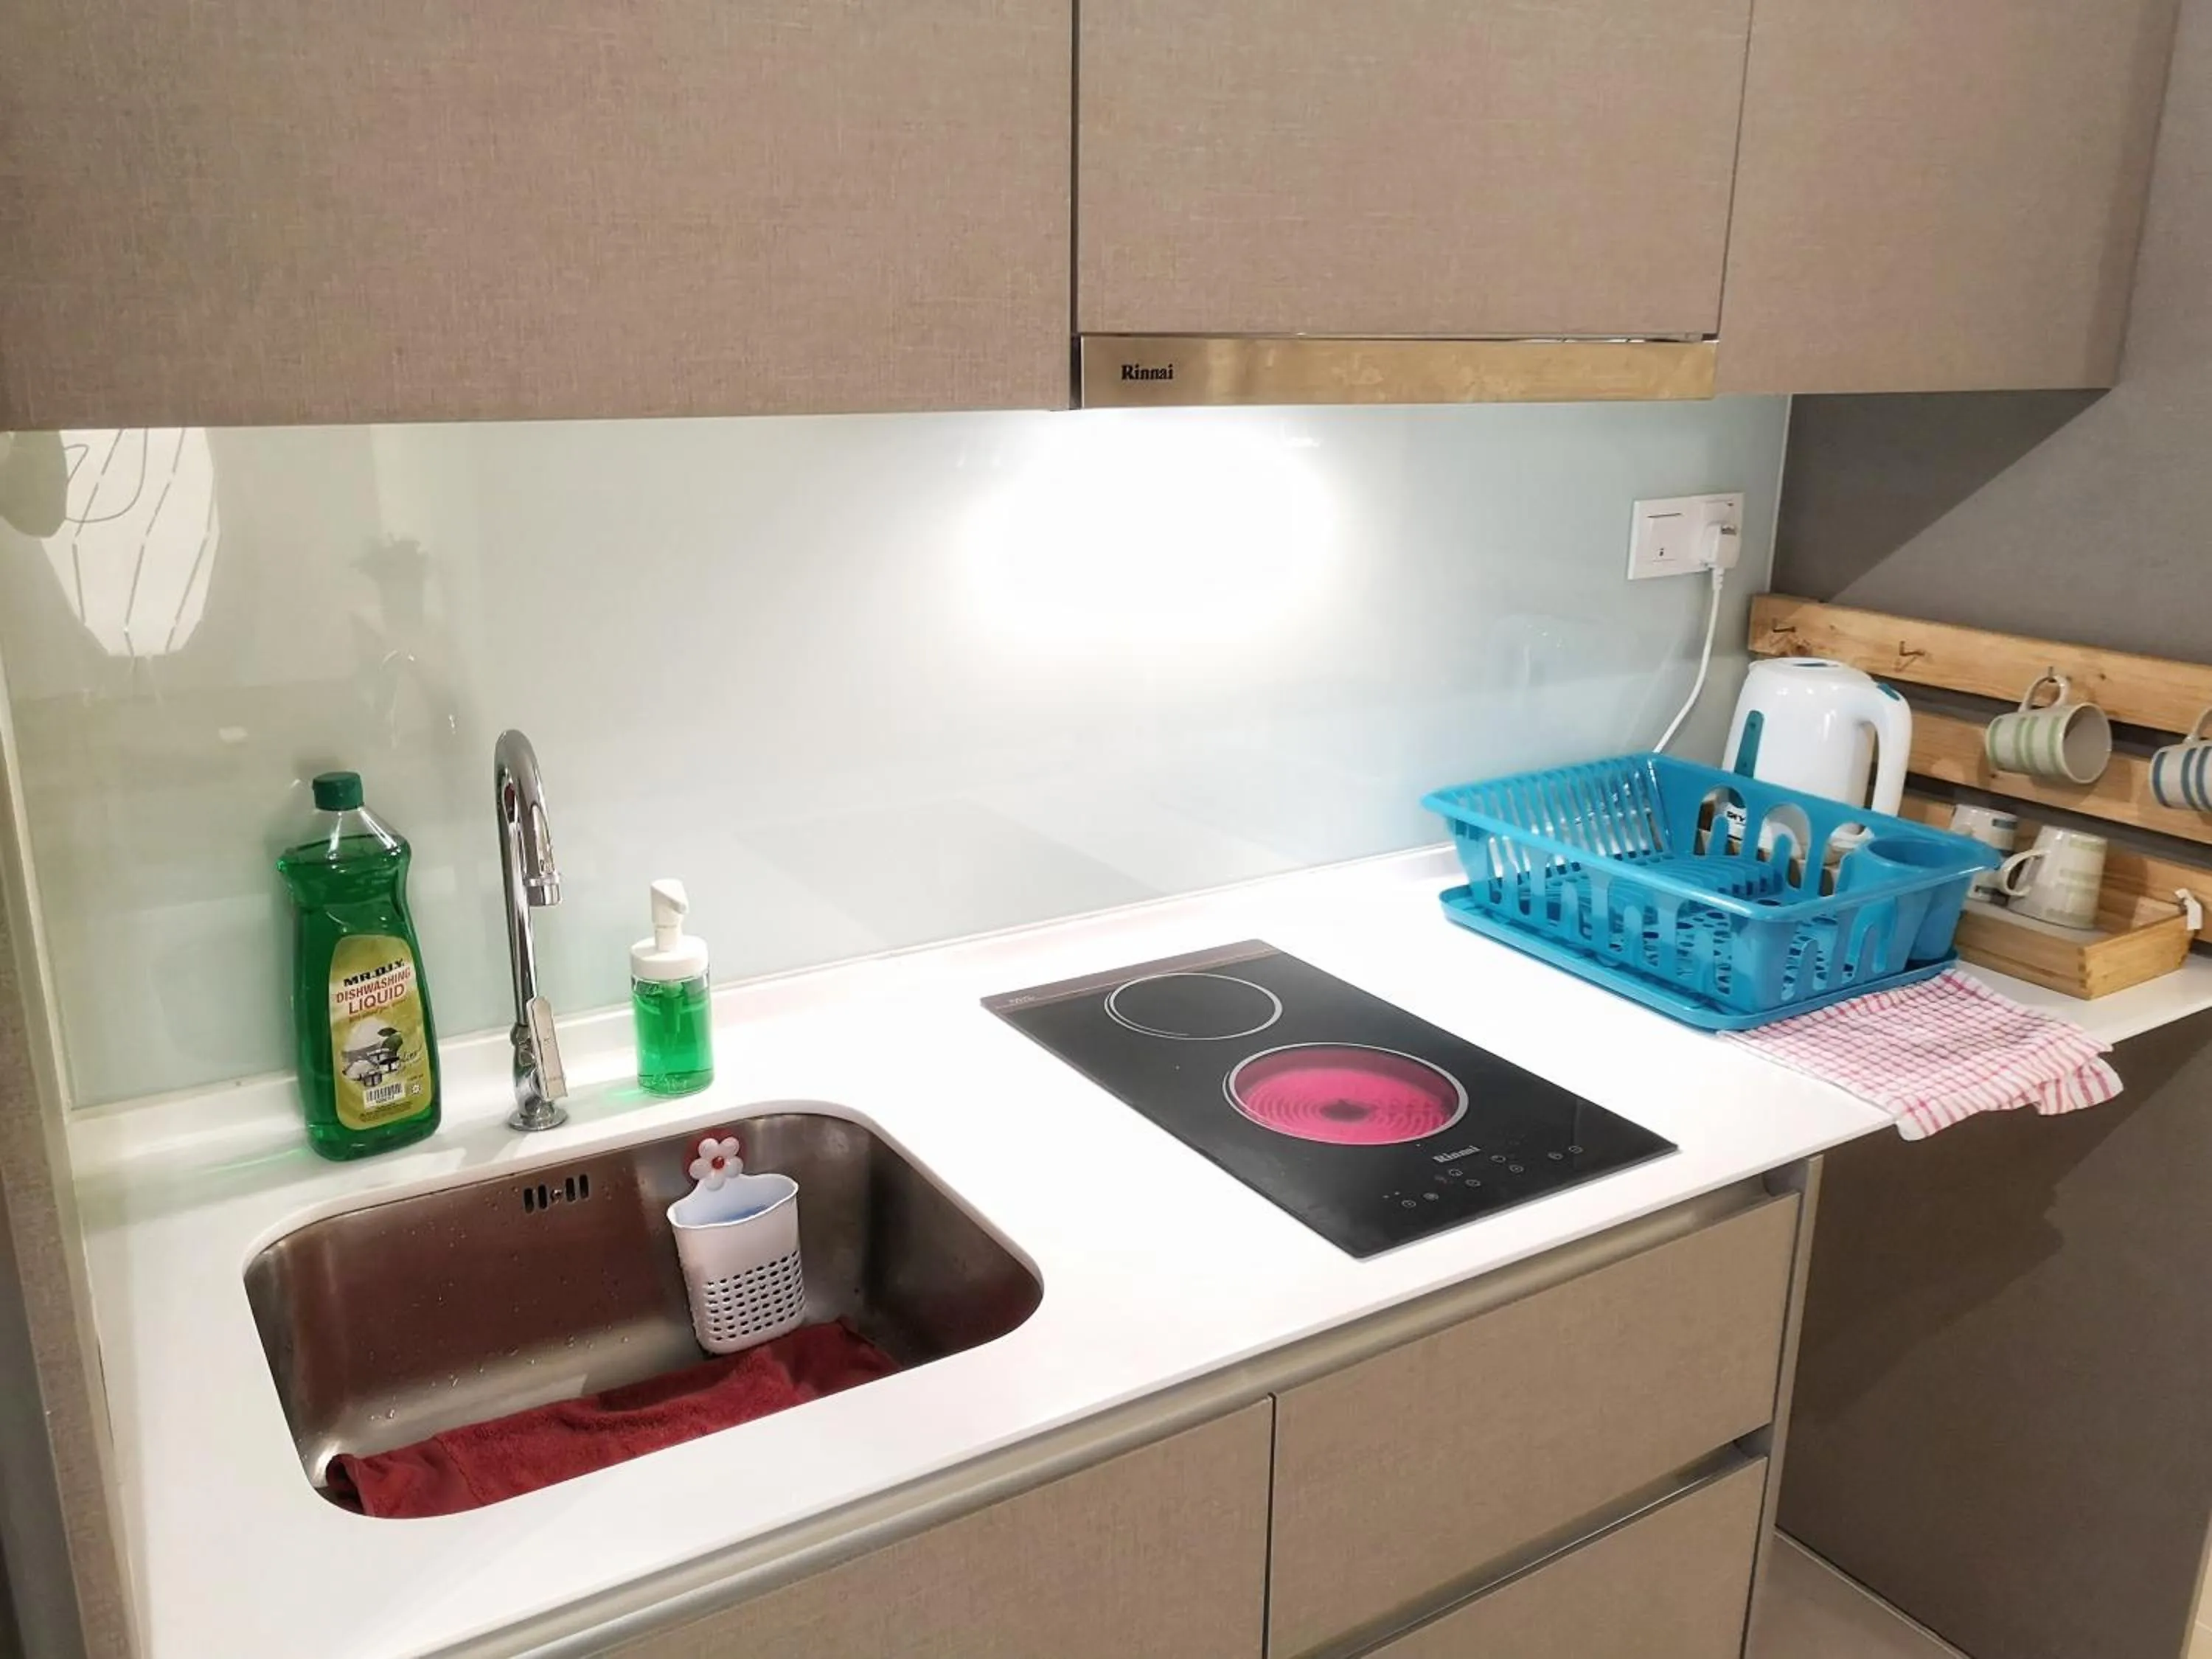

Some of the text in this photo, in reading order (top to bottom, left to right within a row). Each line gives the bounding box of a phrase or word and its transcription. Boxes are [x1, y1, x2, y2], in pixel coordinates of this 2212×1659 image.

[1121, 364, 1173, 380] Rinnai
[336, 967, 411, 1004] DISHWASHING
[349, 983, 405, 1015] LIQUID
